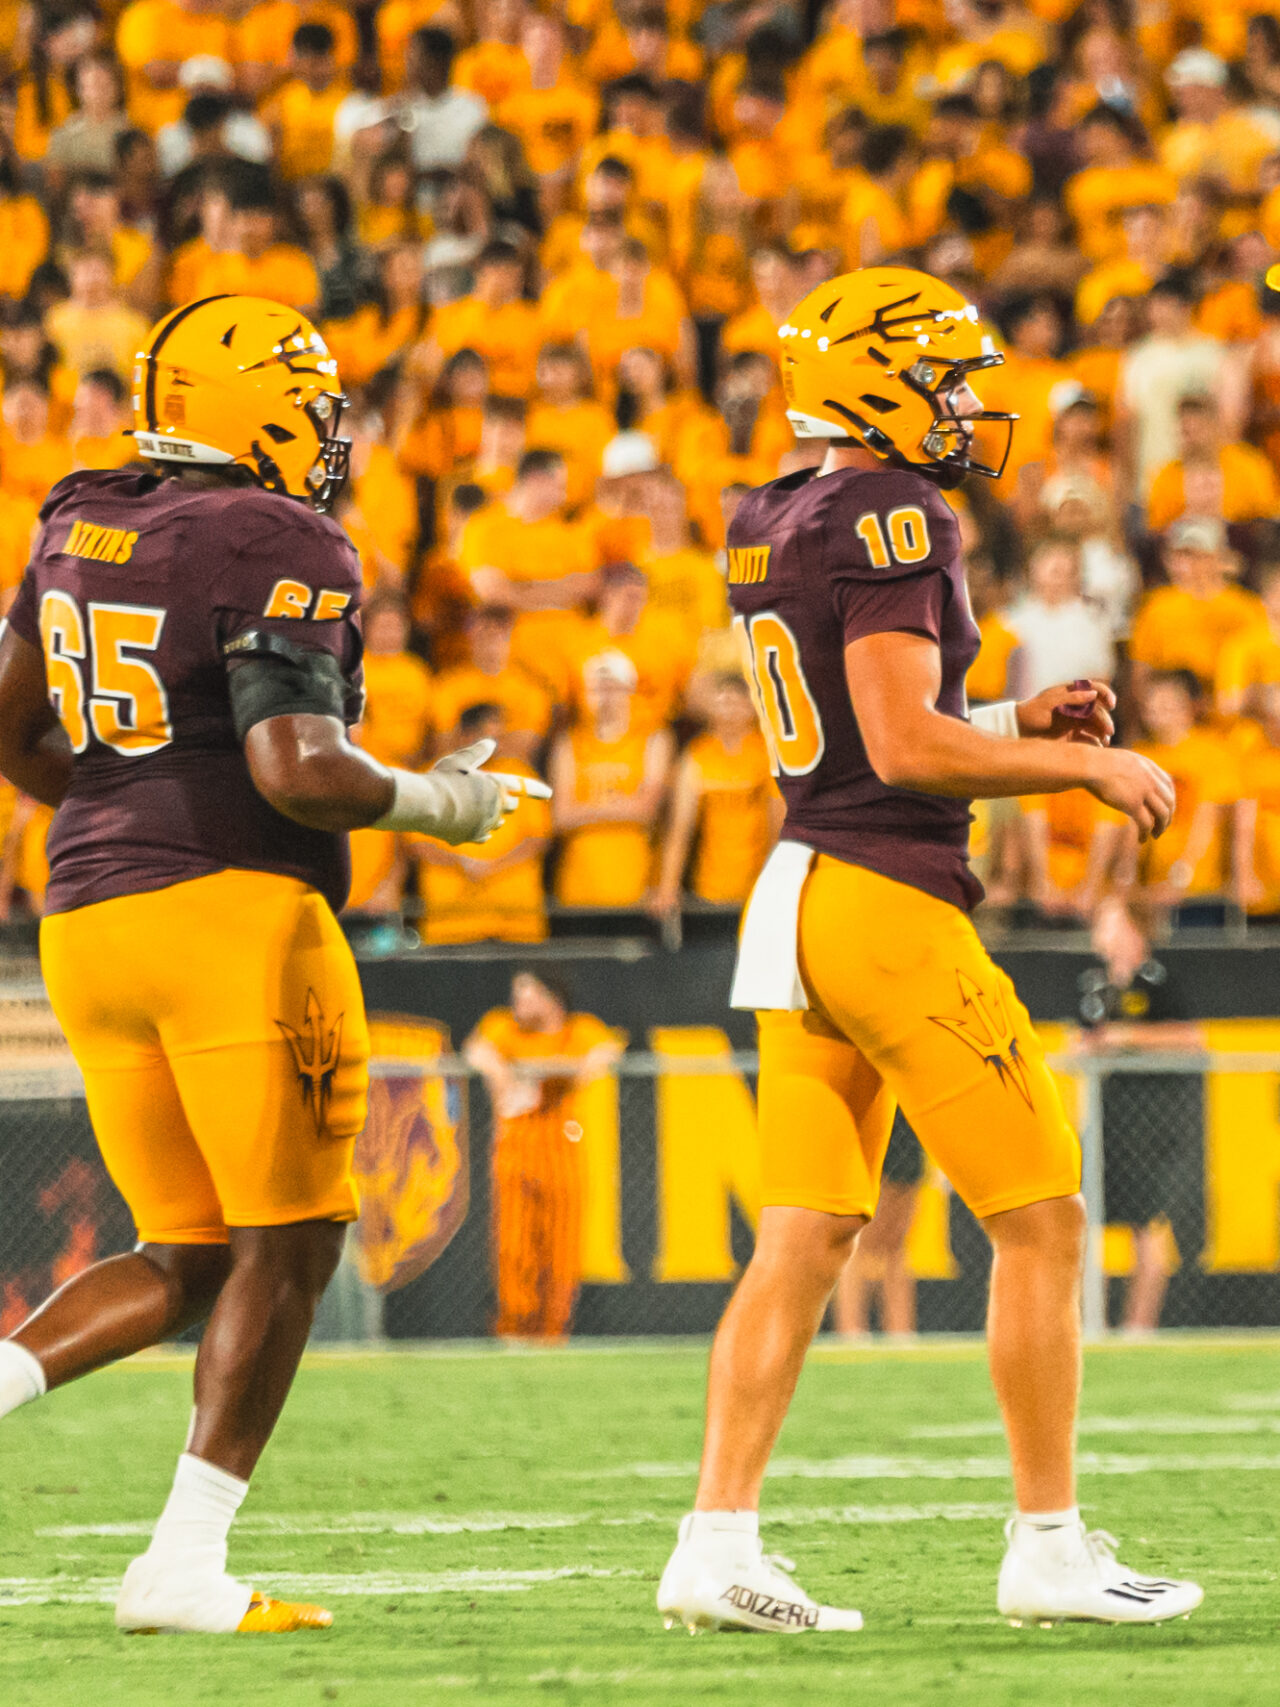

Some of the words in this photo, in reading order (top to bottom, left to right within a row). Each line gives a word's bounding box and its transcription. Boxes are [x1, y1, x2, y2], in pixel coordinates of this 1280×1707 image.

[62, 519, 138, 565] ATKINS
[856, 506, 931, 569] 10
[39, 589, 173, 757] 65
[718, 1584, 819, 1627] ADIZERO
